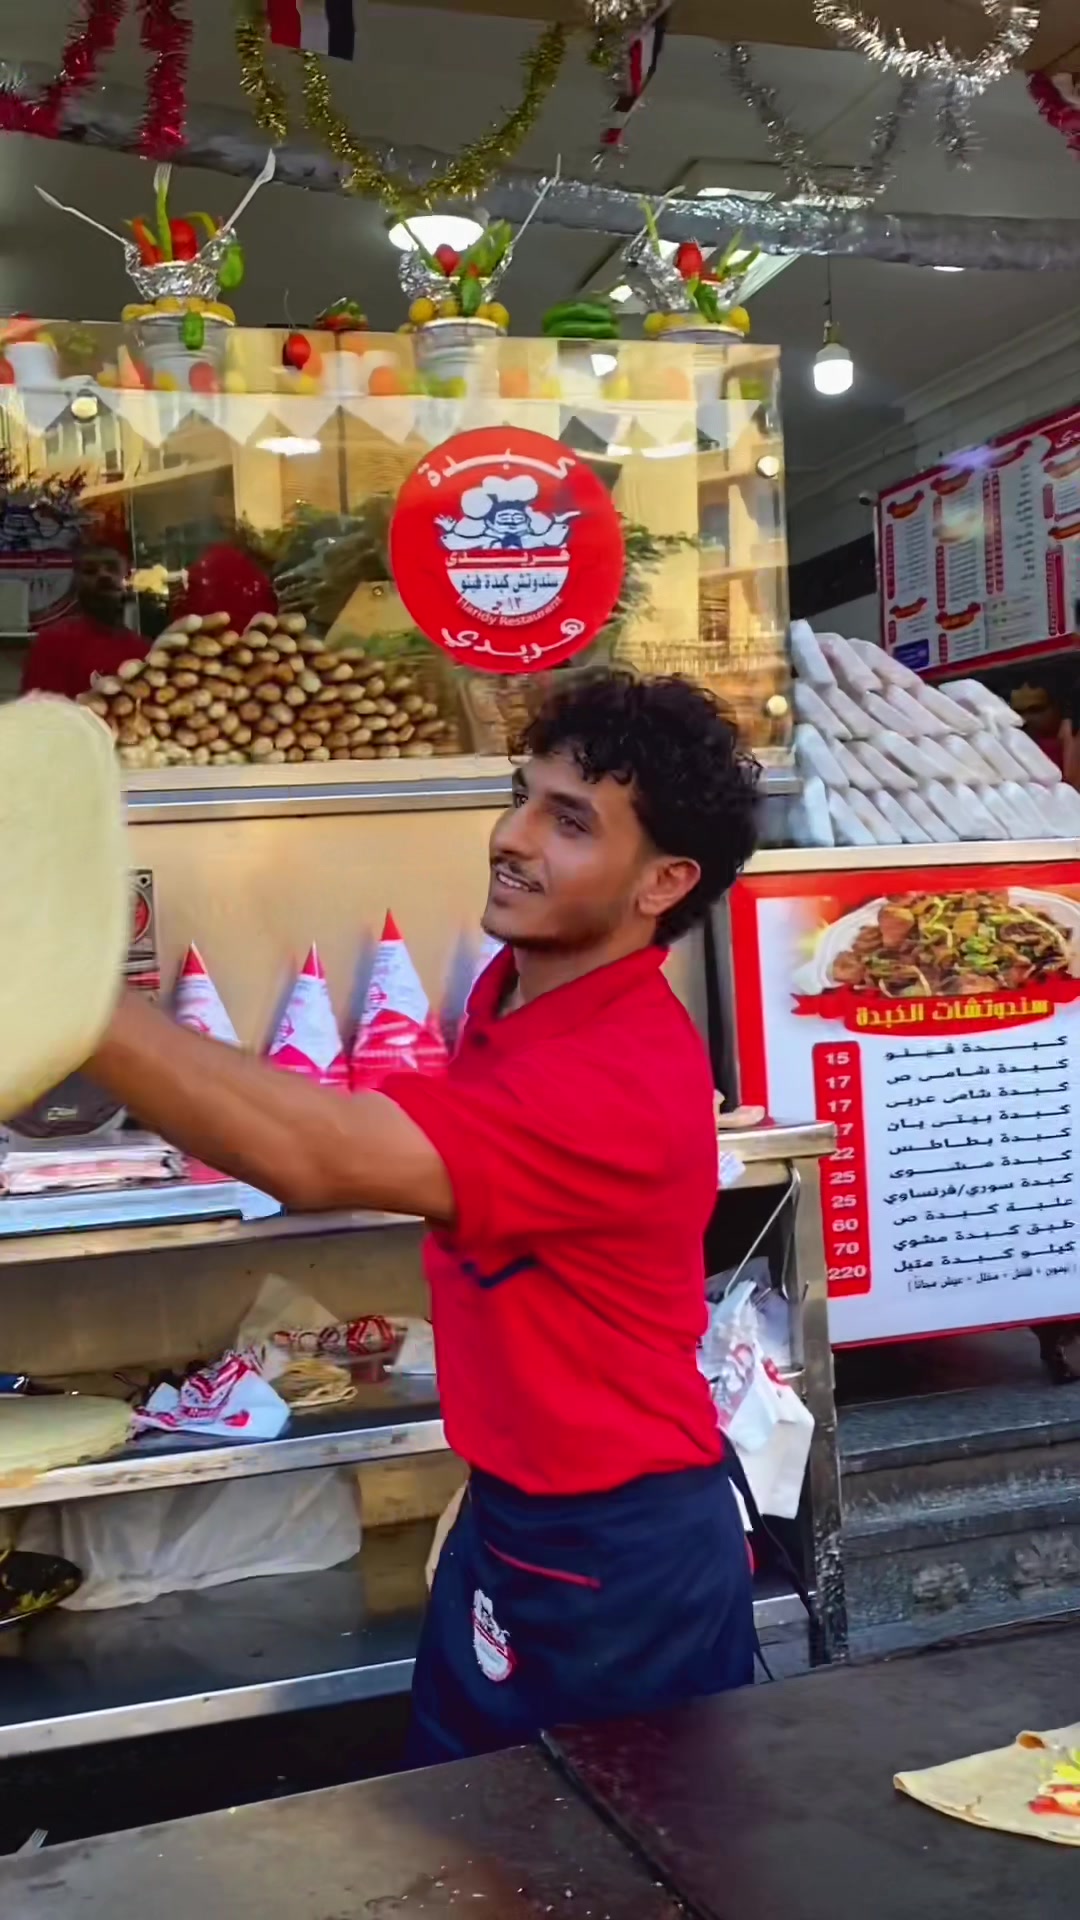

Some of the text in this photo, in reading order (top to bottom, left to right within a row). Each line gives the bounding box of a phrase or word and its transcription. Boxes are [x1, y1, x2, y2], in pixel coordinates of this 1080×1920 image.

[417, 448, 576, 487] كبدة
[484, 573, 509, 593] كبدة
[498, 596, 563, 627] Restaurant
[856, 996, 1049, 1029] سندوتشات الكبدة
[962, 1035, 1068, 1053] كبدة
[824, 1051, 850, 1065] 15
[997, 1058, 1069, 1074] كبدة
[825, 1075, 852, 1089] 17
[998, 1081, 1070, 1097] كبدة
[827, 1098, 852, 1113] 17
[999, 1104, 1071, 1120] كبدة
[839, 1122, 854, 1136] 7
[888, 1127, 1072, 1155] كبدة بطاطس
[829, 1146, 855, 1161] 22
[1001, 1149, 1072, 1167] كبدة
[829, 1170, 856, 1185] 25
[1020, 1172, 1074, 1187] كبدة
[831, 1194, 857, 1209] 25
[1006, 1195, 1073, 1212] علبة
[925, 1203, 999, 1221] كبدة
[831, 1218, 859, 1233] 60
[955, 1224, 1020, 1241] كبدة
[1025, 1219, 1076, 1236] طبق
[833, 1241, 860, 1256] 70
[941, 1247, 1015, 1266] كبدة
[1020, 1240, 1076, 1259] كيلو
[828, 1264, 867, 1281] 220
